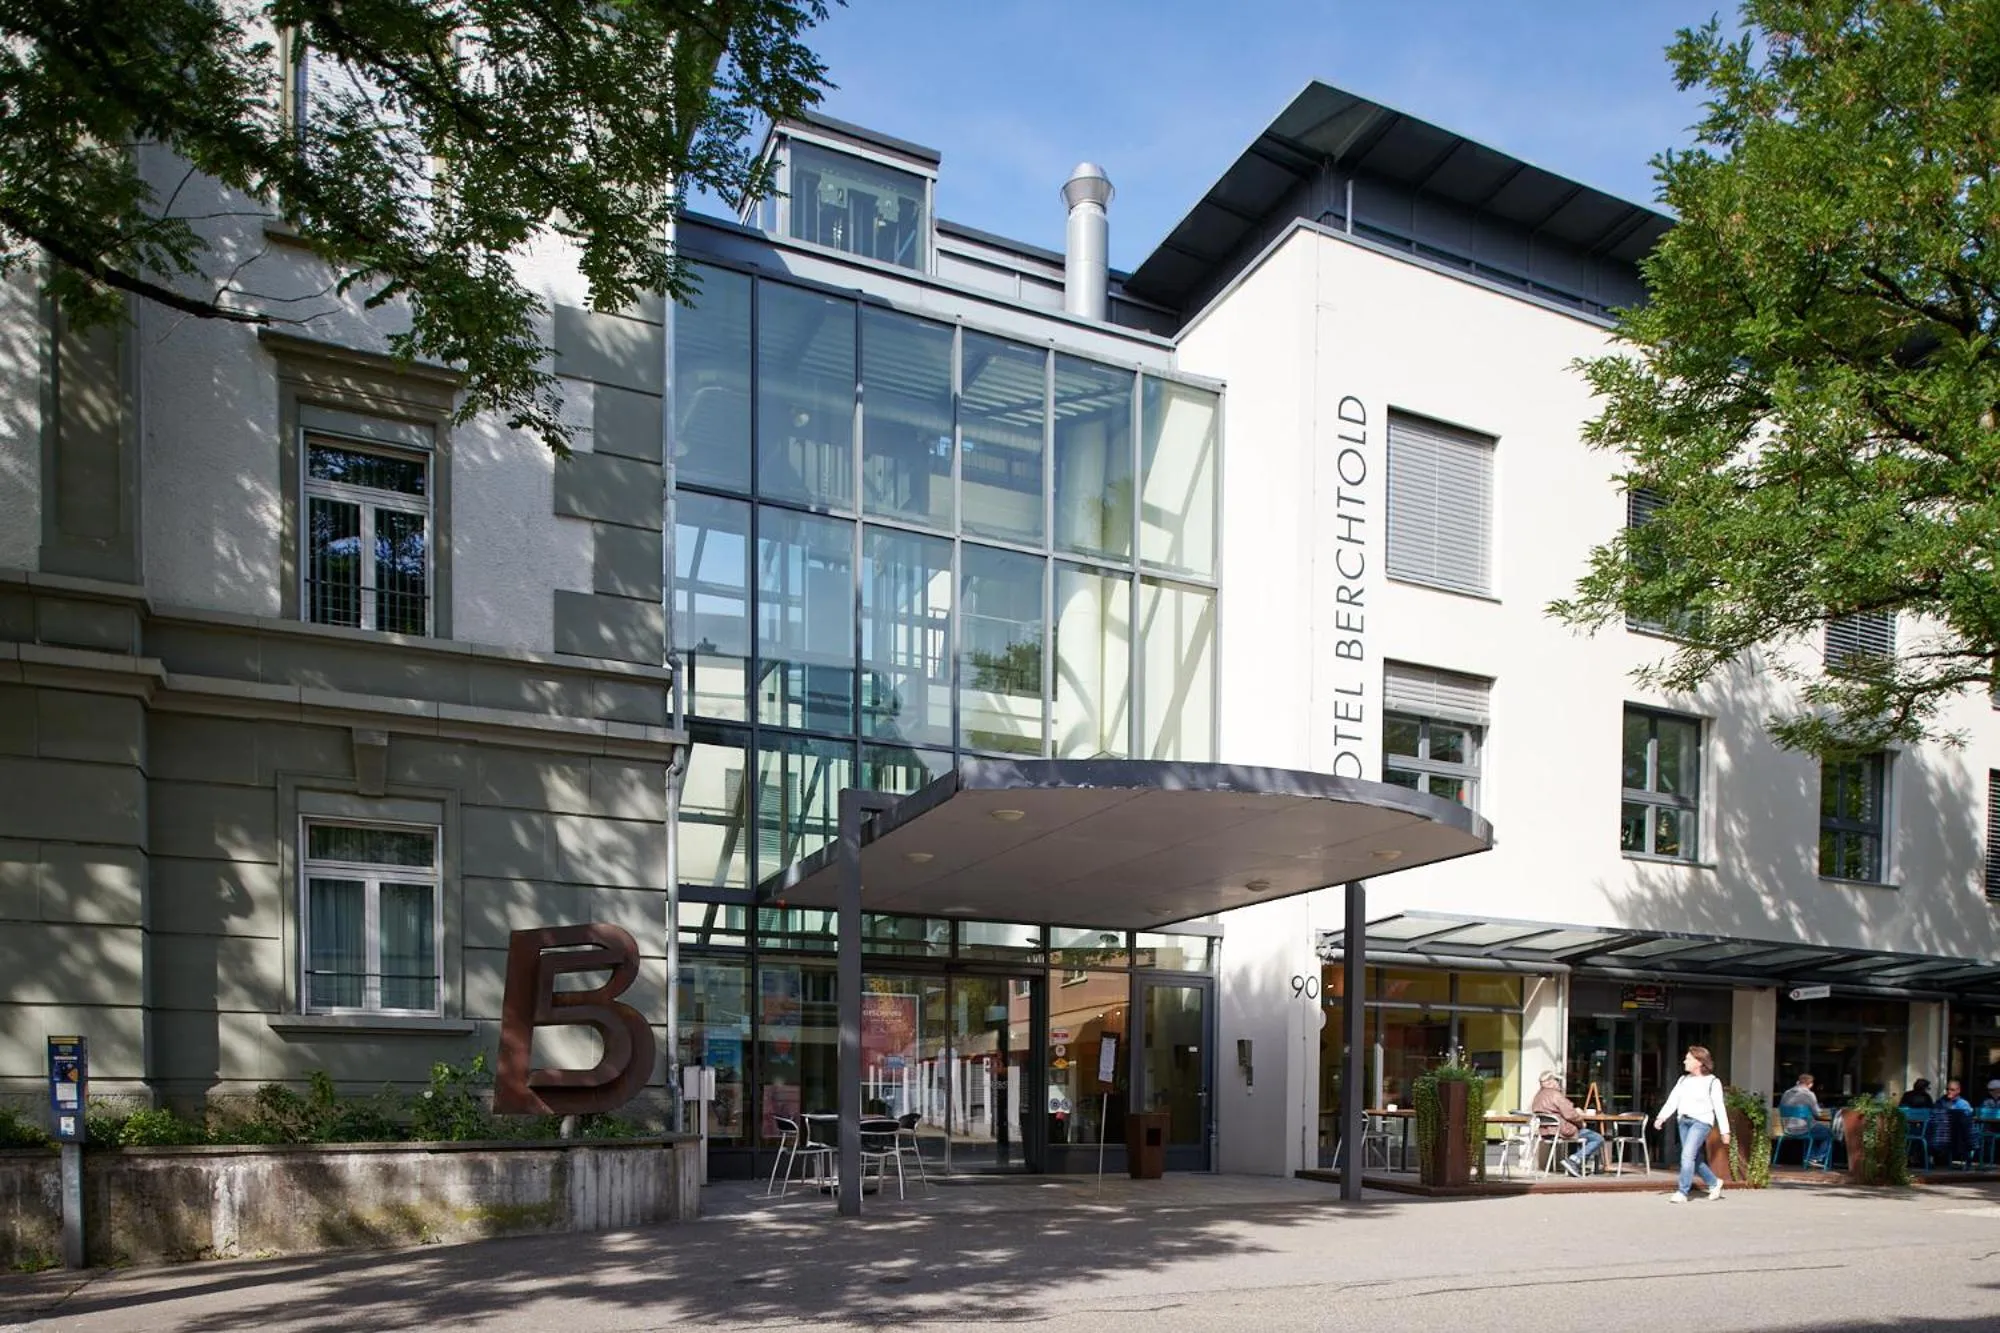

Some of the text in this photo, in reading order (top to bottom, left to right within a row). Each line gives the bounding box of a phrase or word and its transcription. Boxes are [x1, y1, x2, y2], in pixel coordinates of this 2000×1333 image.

[1333, 395, 1367, 779] OTEL BERCHTOLD
[493, 923, 656, 1114] B
[1291, 975, 1320, 1000] 90
